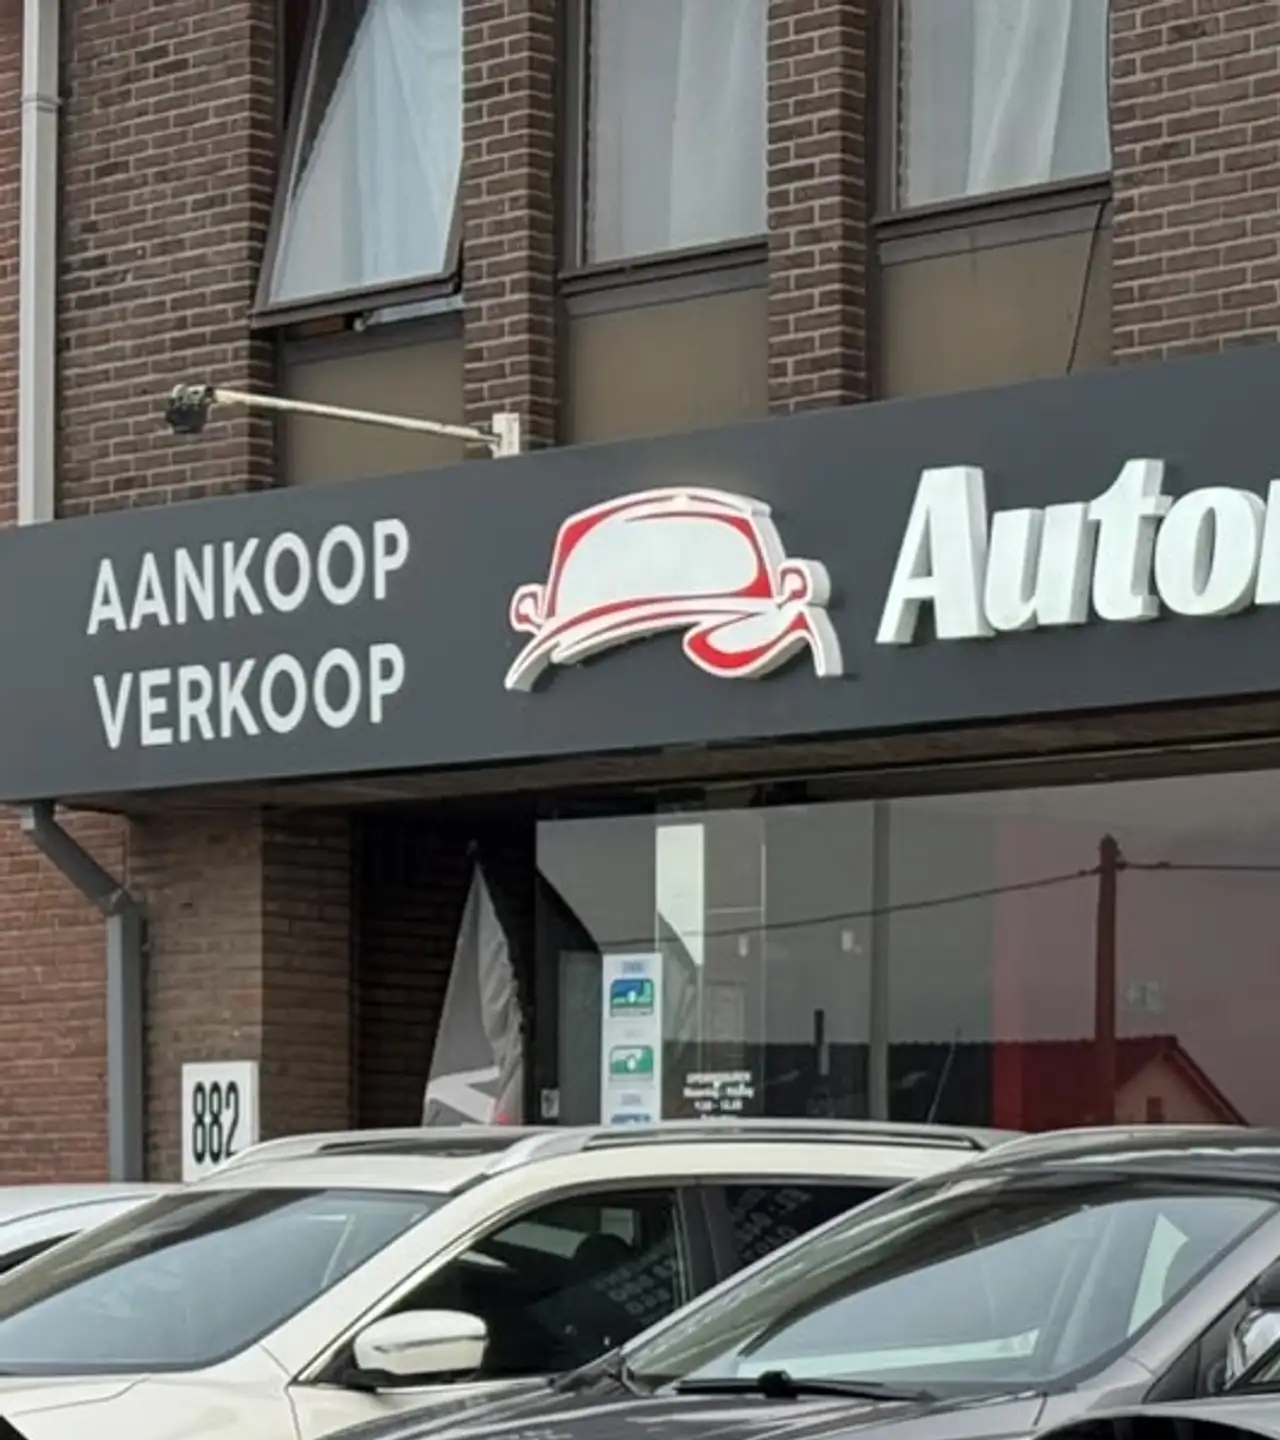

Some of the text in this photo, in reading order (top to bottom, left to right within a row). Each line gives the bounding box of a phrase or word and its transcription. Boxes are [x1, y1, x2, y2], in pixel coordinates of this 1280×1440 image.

[87, 518, 409, 635] AANKOOP
[93, 643, 405, 749] VERKOOP
[192, 1081, 239, 1165] 882
